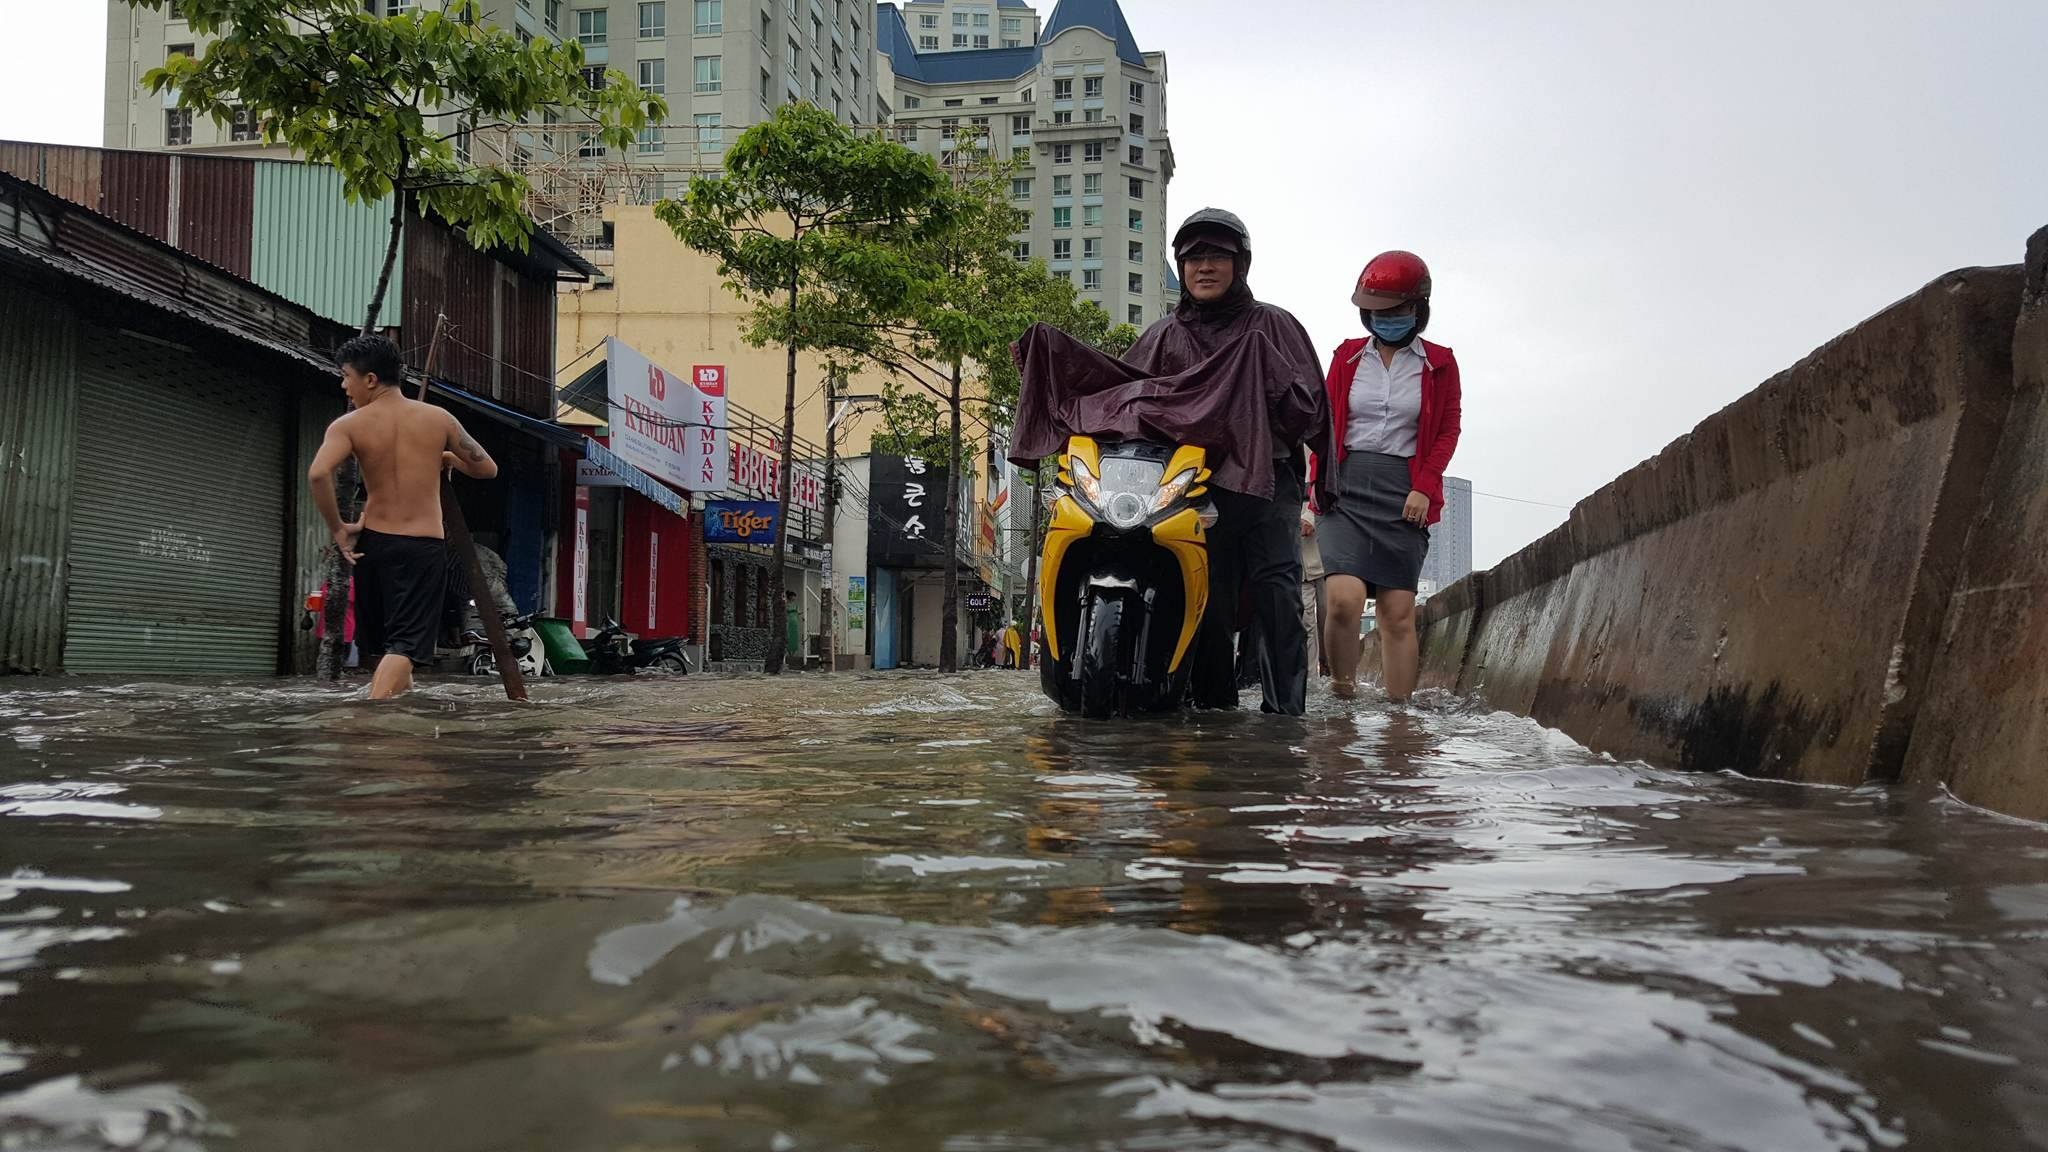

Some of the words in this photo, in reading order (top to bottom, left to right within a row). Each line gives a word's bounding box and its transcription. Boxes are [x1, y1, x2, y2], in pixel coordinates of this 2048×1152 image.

[624, 393, 686, 456] KYMDAN
[701, 400, 717, 484] KYMDAN
[735, 442, 769, 501] BBQ
[789, 464, 825, 512] BEER
[719, 510, 773, 538] Tiger
[576, 521, 586, 610] KYMDAN
[969, 598, 987, 606] GOLF
